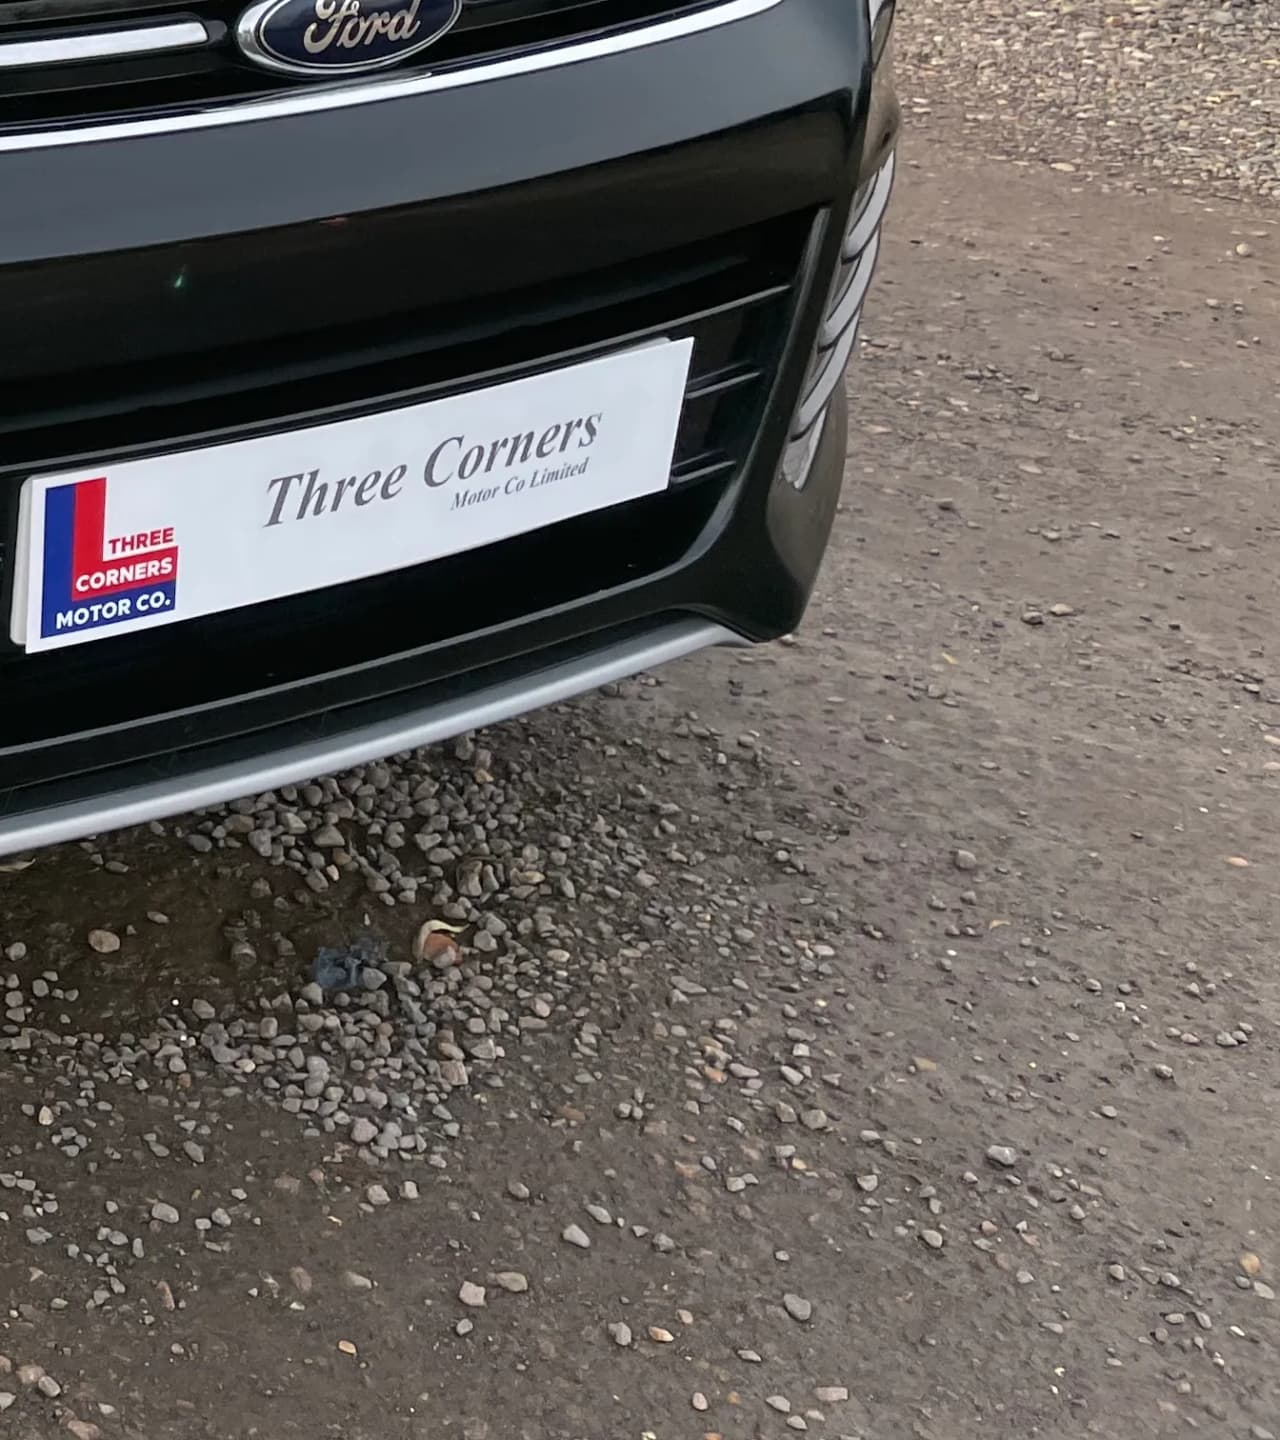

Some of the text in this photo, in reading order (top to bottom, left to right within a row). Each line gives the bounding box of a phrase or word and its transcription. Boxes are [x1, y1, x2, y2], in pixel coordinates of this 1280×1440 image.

[263, 413, 603, 527] Three Corners
[450, 457, 590, 511] Motor Co Limited
[108, 527, 175, 555] THREE
[75, 557, 174, 592] CORNERS
[55, 591, 172, 630] MOTOR CO.
